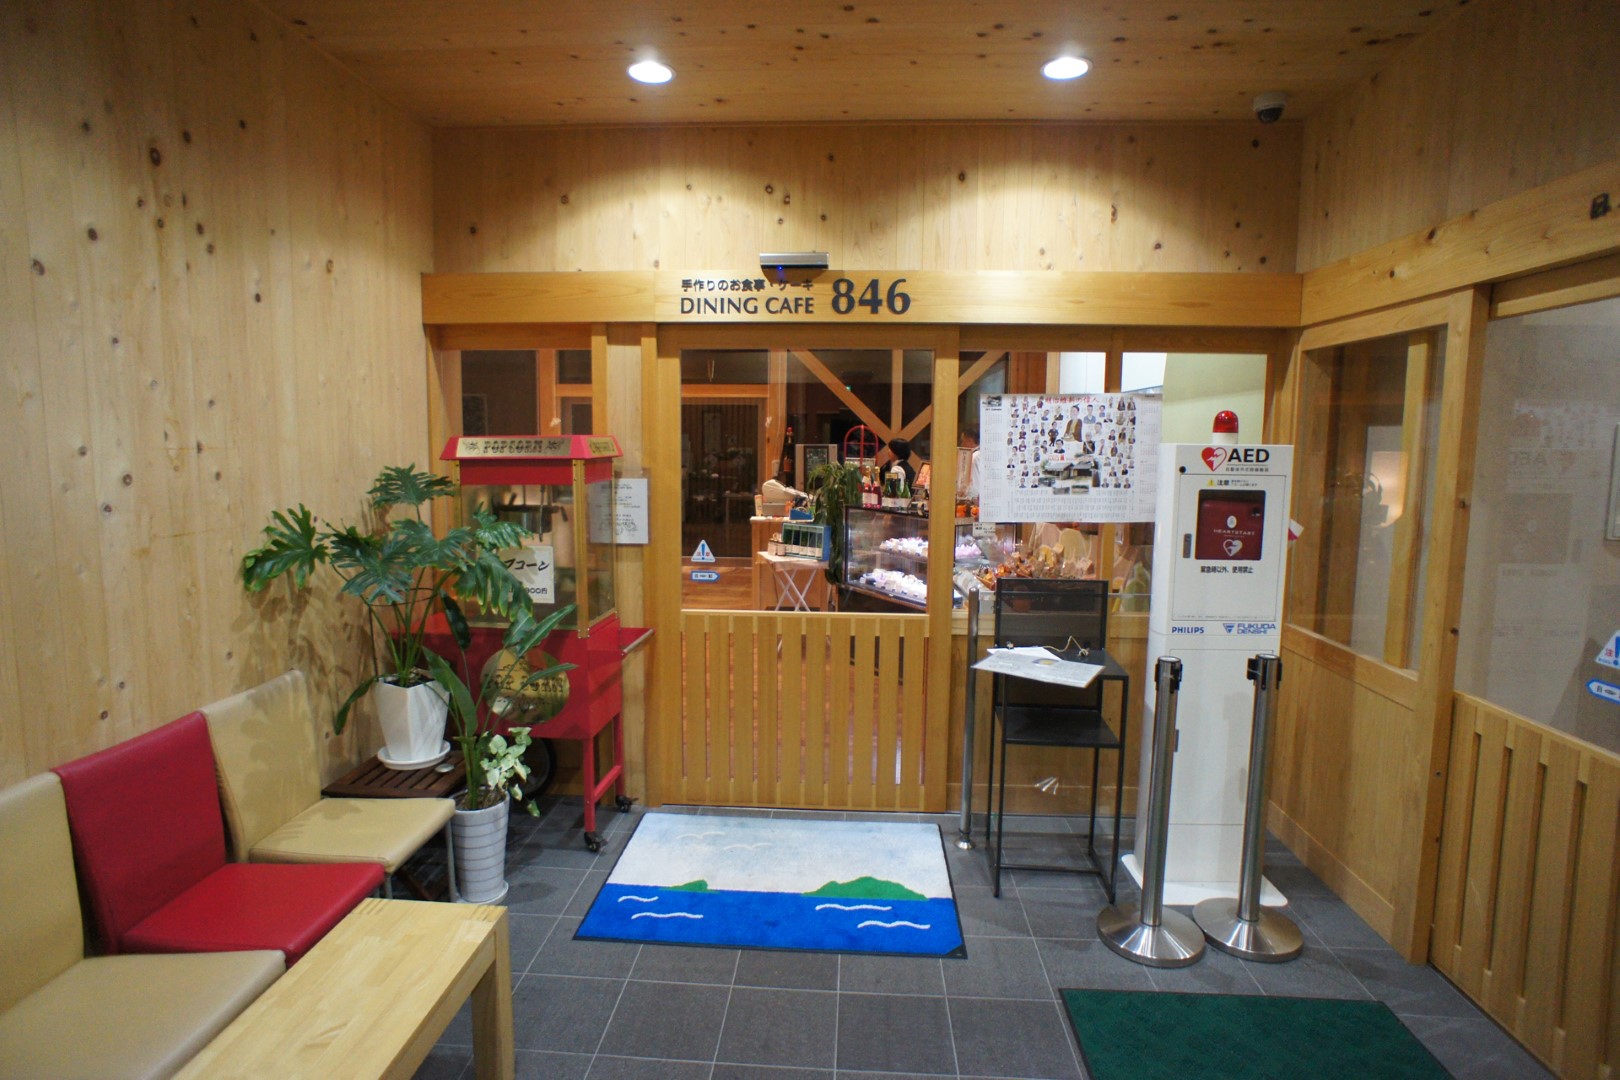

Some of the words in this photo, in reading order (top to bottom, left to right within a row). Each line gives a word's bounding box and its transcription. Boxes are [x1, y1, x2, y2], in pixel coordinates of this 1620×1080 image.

[831, 277, 911, 315] 846
[680, 297, 758, 315] DINING
[765, 297, 815, 315] CAFE
[1228, 448, 1270, 463] AED
[1171, 626, 1205, 634] PHILIPS
